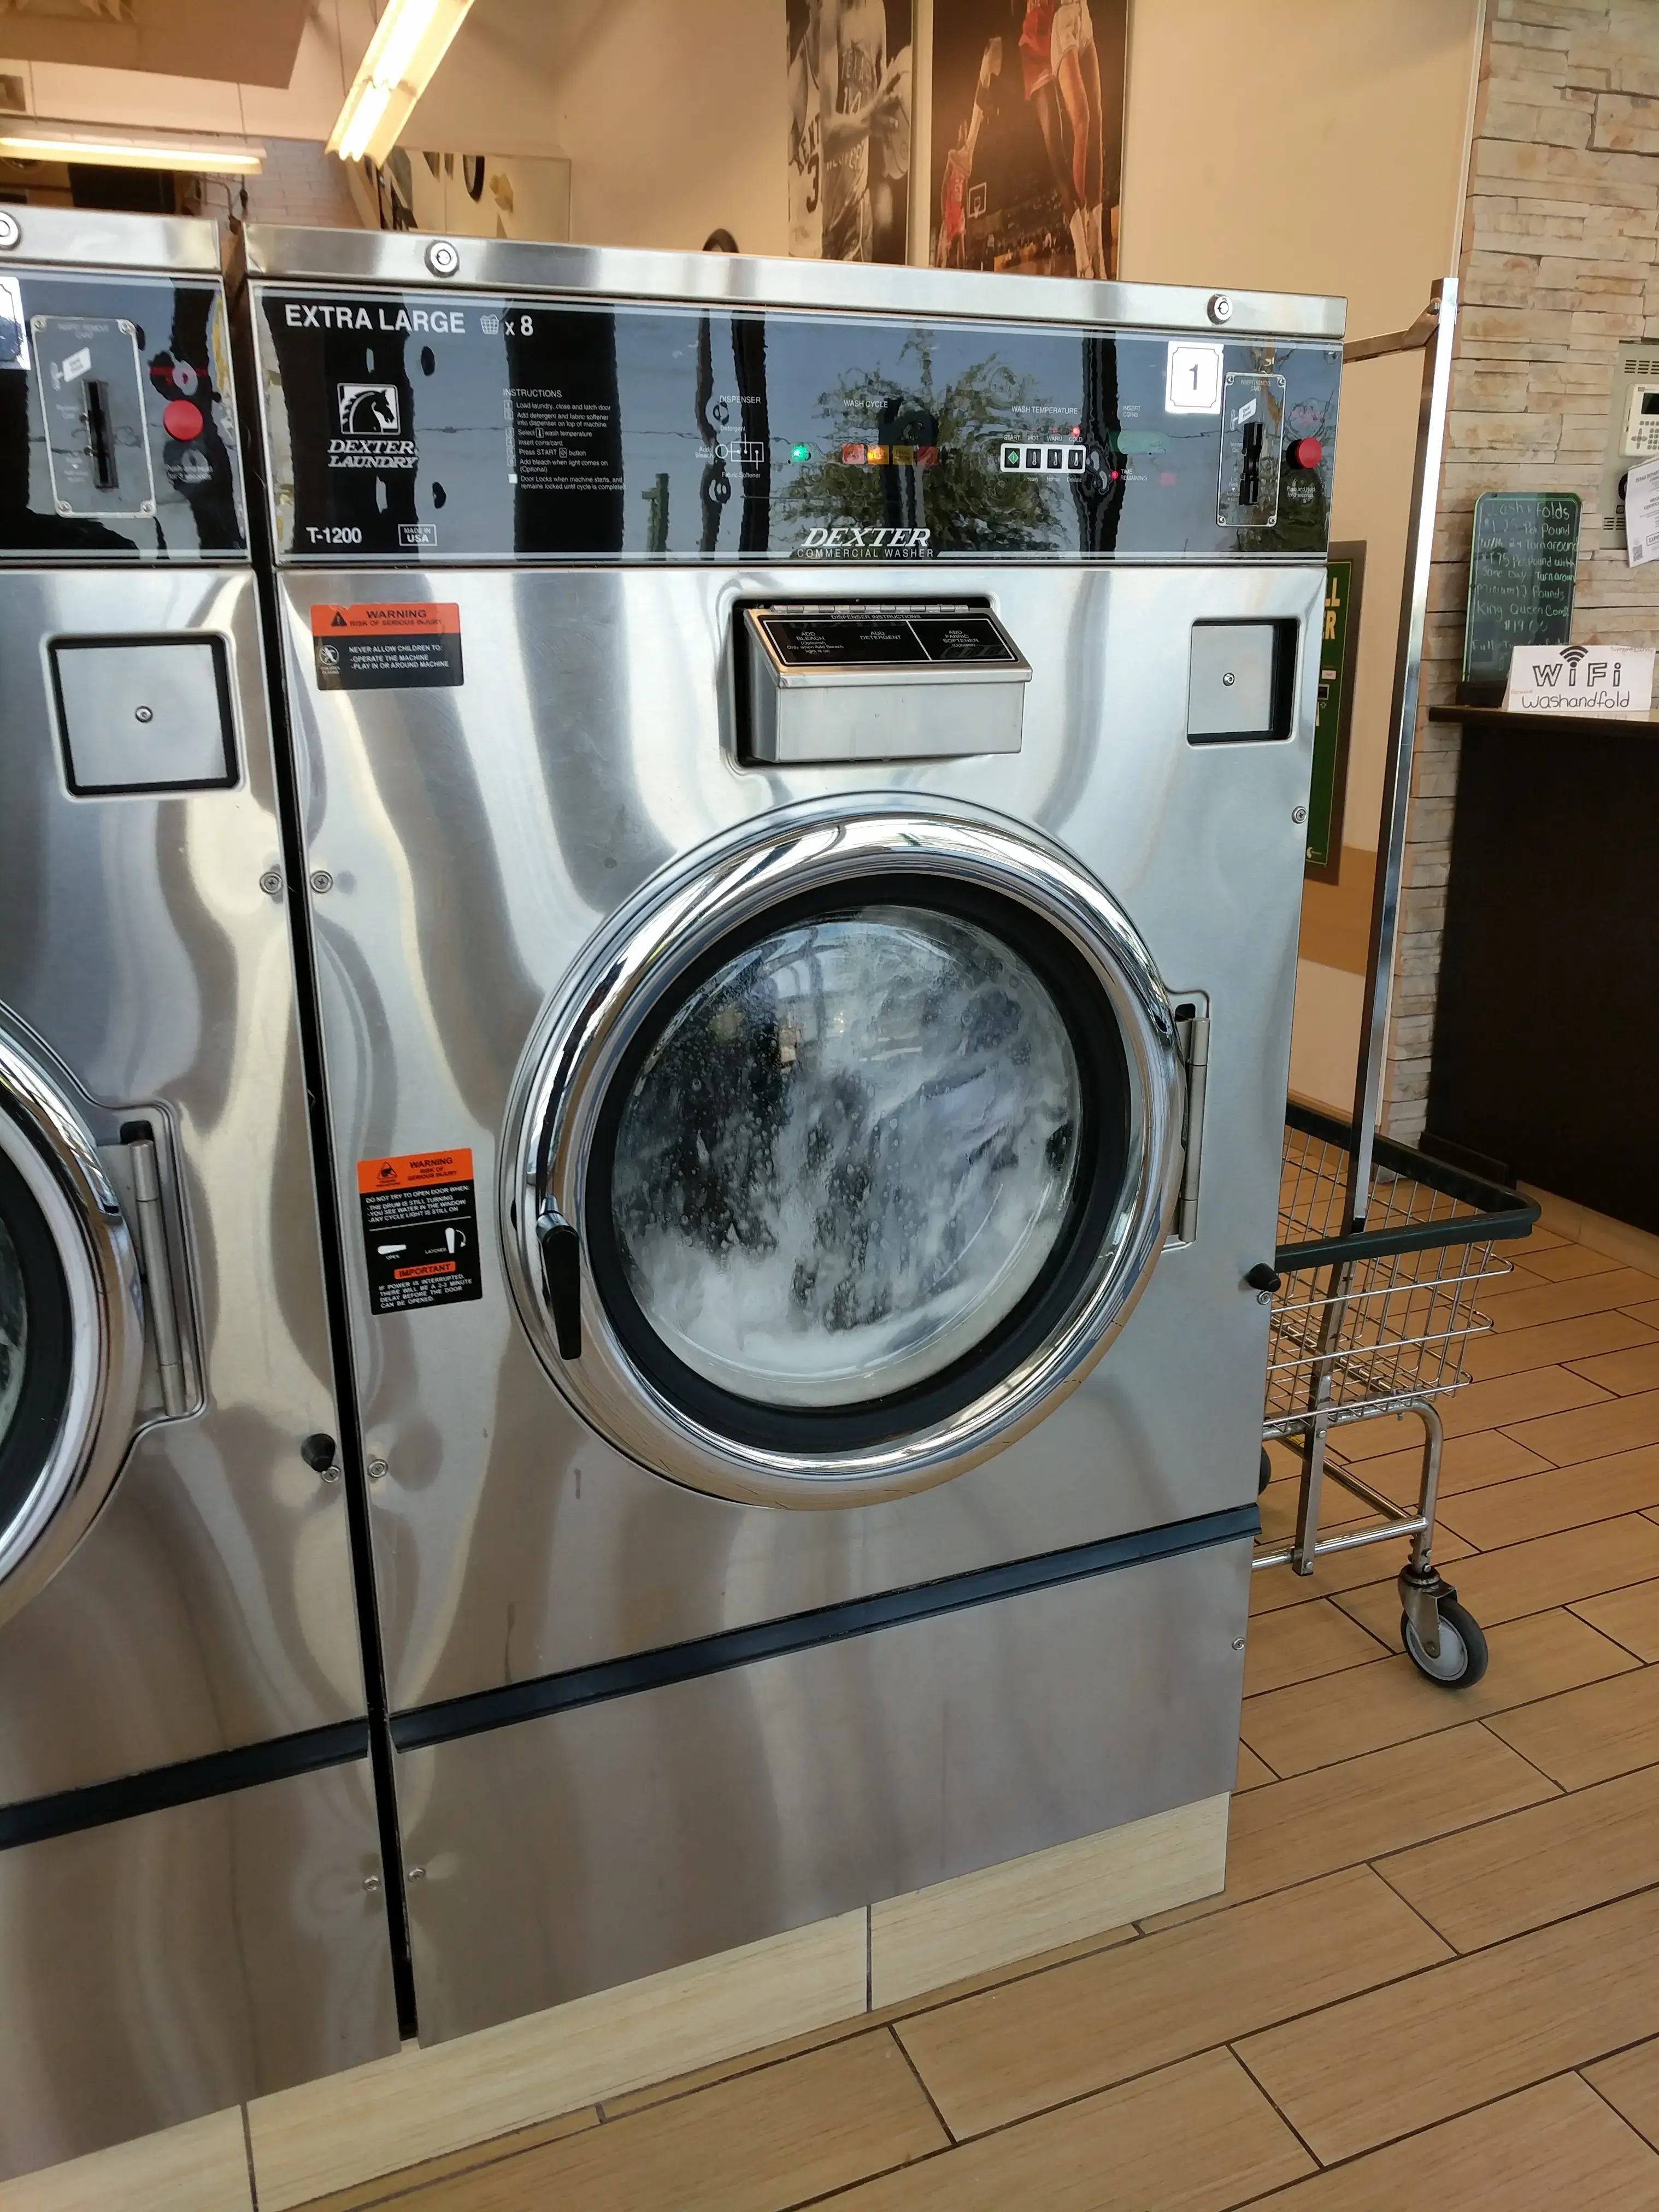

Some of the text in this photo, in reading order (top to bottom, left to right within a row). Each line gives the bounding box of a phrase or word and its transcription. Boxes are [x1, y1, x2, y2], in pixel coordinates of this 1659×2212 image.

[285, 304, 373, 330] EXTRA
[379, 308, 466, 333] LARGE
[521, 315, 534, 336] 8
[1189, 364, 1198, 390] 1
[503, 388, 562, 398] INSTRUCTIONS
[327, 439, 414, 454] DEXTER
[328, 455, 419, 468] LAUNDRY
[1537, 502, 1570, 519] Folds
[306, 527, 362, 544] T-1200
[407, 534, 430, 543] USA
[801, 527, 931, 547] DEXTER
[797, 549, 933, 558] COMMERCIAL WASHER
[366, 609, 427, 619] WARNING
[1477, 600, 1543, 622] King Queen
[1532, 661, 1622, 687] WiFi
[1522, 690, 1631, 709] washandfold
[409, 1157, 453, 1169] WARNING
[426, 1195, 454, 1203] TURNING
[440, 1199, 466, 1207] WINDOW
[384, 1213, 405, 1221] CYCLE
[399, 1263, 450, 1278] IMPORTANT
[379, 1289, 401, 1297] THERE
[402, 1291, 428, 1299] BEFORE
